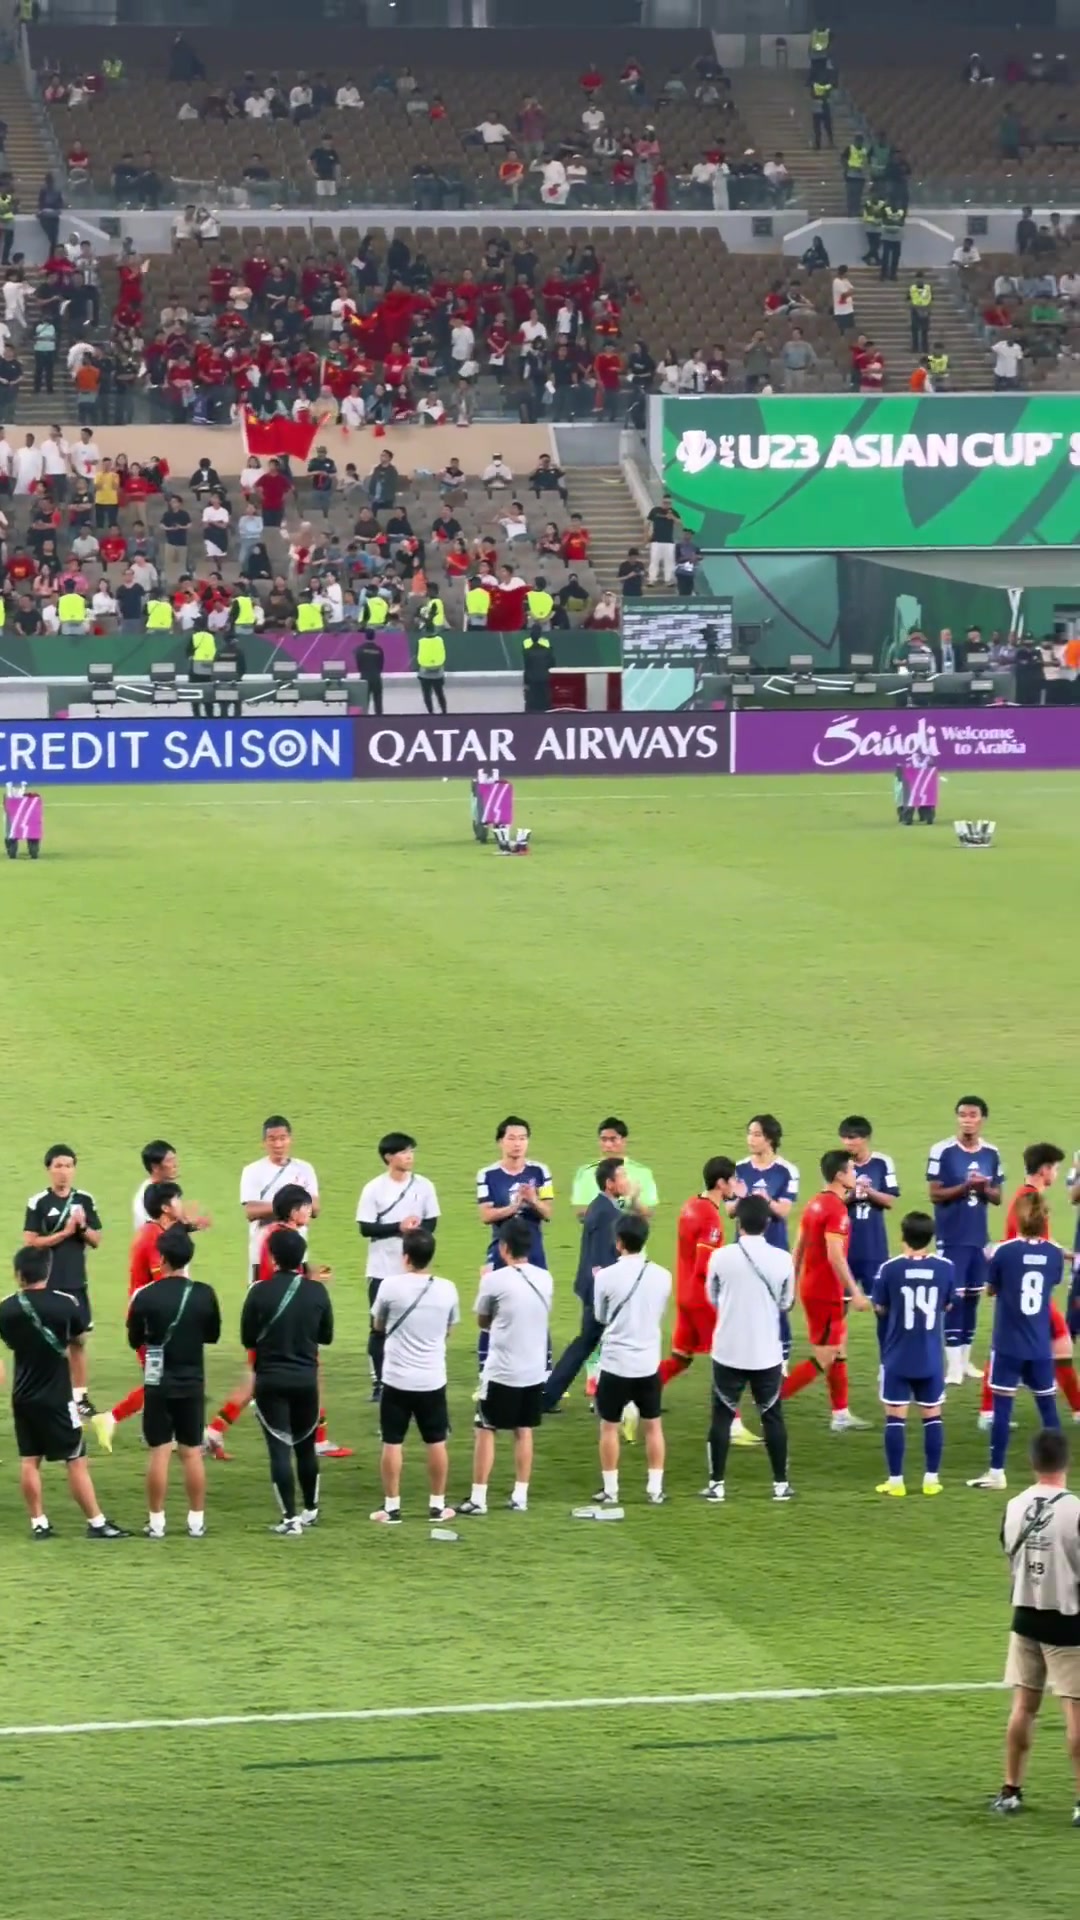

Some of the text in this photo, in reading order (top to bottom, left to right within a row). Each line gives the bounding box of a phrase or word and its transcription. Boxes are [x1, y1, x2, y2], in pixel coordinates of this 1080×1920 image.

[738, 434, 820, 469] U23
[824, 433, 958, 469] ASIAN
[962, 432, 1053, 467] CUP
[0, 729, 340, 772] REDIT SAISON
[368, 725, 718, 766] QATAR AIRWAYS
[813, 715, 941, 766] Saudi
[940, 725, 1014, 741] Welcome
[955, 741, 1026, 755] to Arabia
[901, 1286, 939, 1330] 14
[1020, 1271, 1045, 1316] 8
